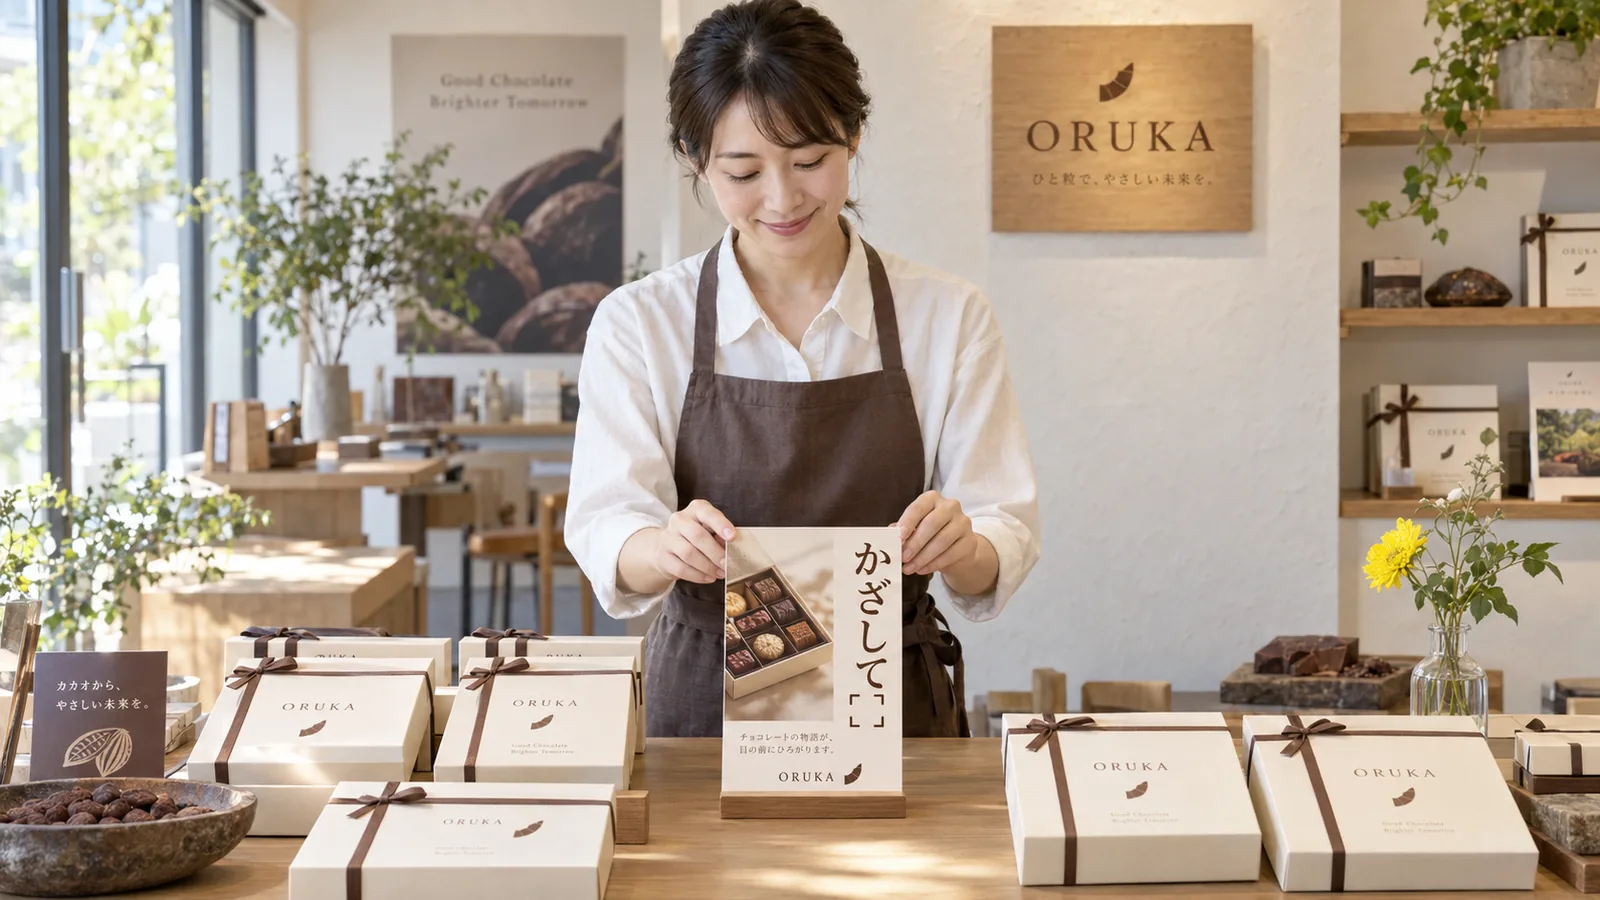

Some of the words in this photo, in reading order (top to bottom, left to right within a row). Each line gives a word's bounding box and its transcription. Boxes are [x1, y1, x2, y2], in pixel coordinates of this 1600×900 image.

[439, 73, 485, 88] Good
[489, 73, 574, 88] Chocolate
[429, 94, 500, 112] Brighter
[506, 94, 590, 109] Tomorrow
[1026, 119, 1216, 153] ORUKA
[1032, 172, 1214, 187] ひと粒で、やさしい未来を。
[1562, 247, 1598, 256] ORUKA
[1427, 428, 1467, 437] ORUKA
[854, 541, 892, 690] かざして
[56, 680, 121, 692] カカオから、
[56, 698, 149, 711] やさしい未来を。
[282, 702, 355, 712] ORUKA
[512, 699, 578, 707] ORUKA
[739, 732, 833, 742] チョコレートの物語が、
[739, 745, 834, 755] 目の前にひろがります。
[1093, 761, 1169, 772] ORUKA
[778, 772, 835, 783] ORUKA
[1353, 768, 1437, 778] ORUKA
[443, 818, 503, 826] ORUKA
